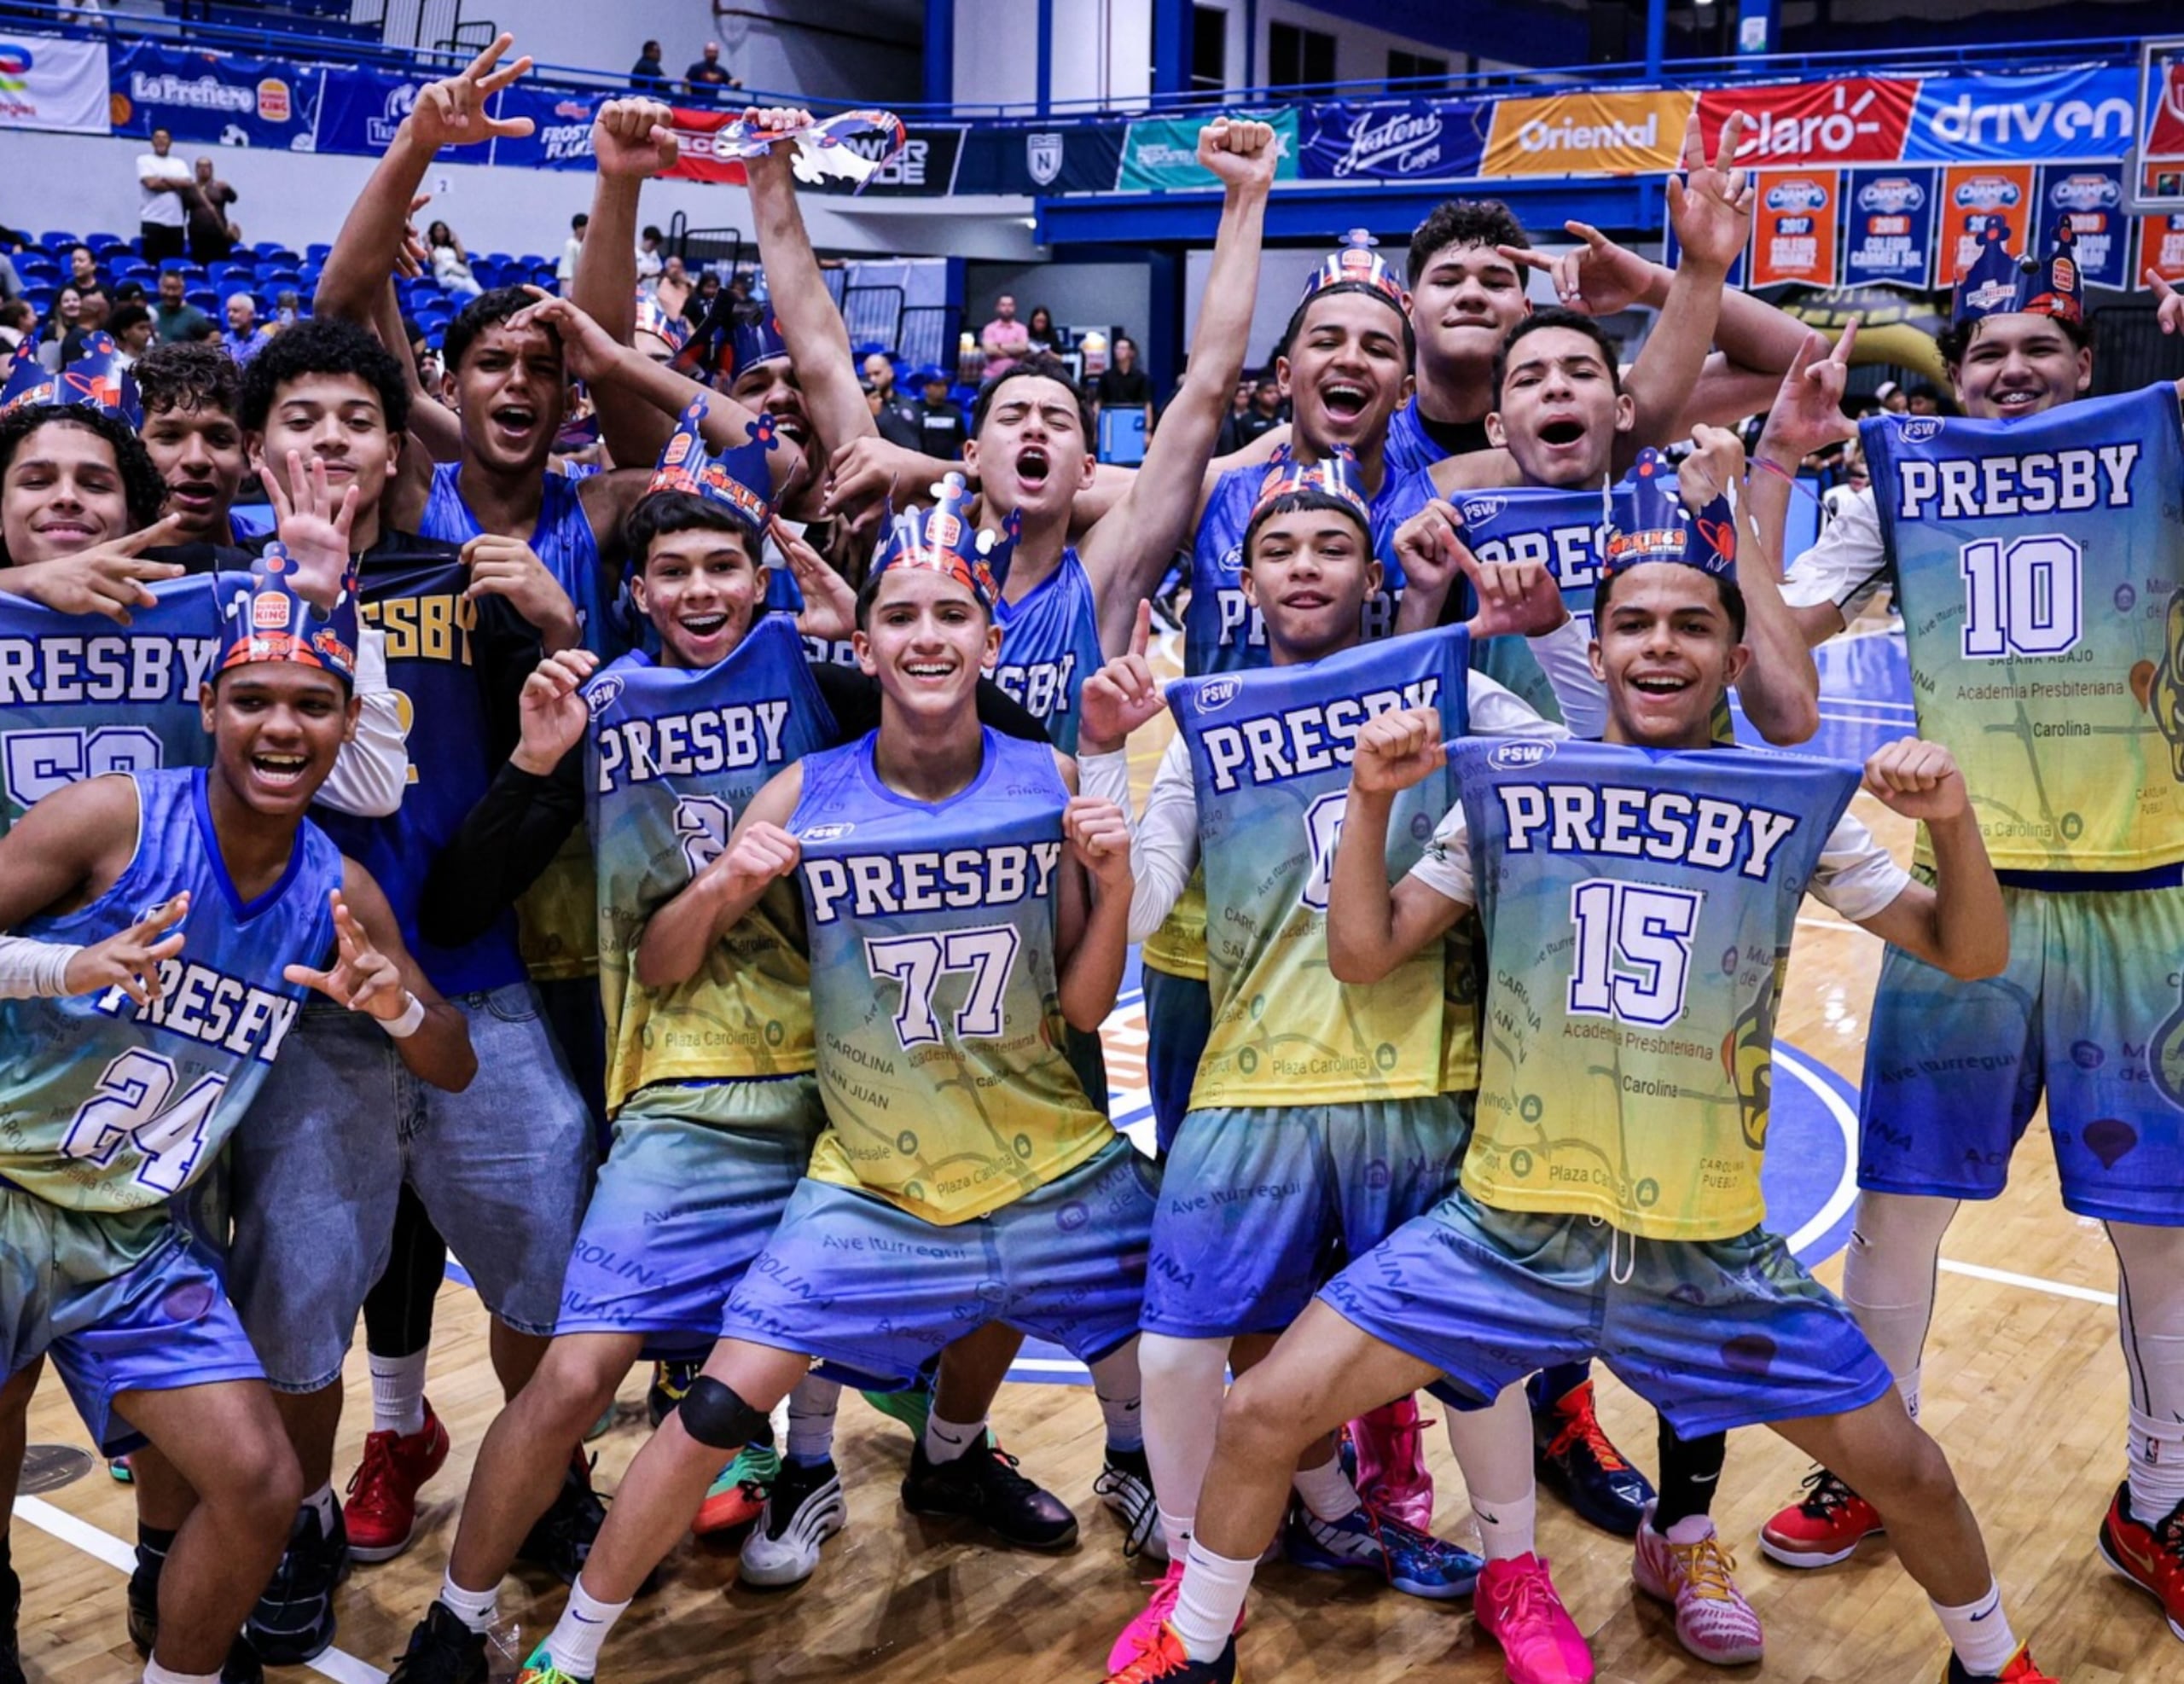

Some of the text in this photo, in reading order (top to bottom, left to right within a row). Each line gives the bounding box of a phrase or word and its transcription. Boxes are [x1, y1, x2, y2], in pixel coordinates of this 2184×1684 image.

[259, 101, 288, 112] KING
[1930, 94, 2133, 144] driven
[1333, 112, 1442, 177] Jostens
[1519, 113, 1658, 152] Oriental
[1720, 110, 1858, 156] Claro
[546, 139, 595, 159] FLAKE
[1903, 417, 1936, 436] PSW
[1899, 444, 2139, 519] PRESBY
[1464, 502, 1498, 521] PSW
[1960, 533, 2082, 659] 10
[256, 610, 288, 620] KING
[586, 682, 616, 711] PSW
[1200, 682, 1235, 703] PSW
[1955, 680, 2124, 701] Academia Presbiteriana
[2032, 720, 2091, 738] Carolina
[598, 700, 789, 793] PRESBY
[1497, 745, 1545, 763] PSW
[1497, 783, 1797, 879] PRESBY
[804, 841, 1062, 924] PRESBY
[1567, 878, 1705, 1030] 15
[863, 922, 1022, 1052] 77
[665, 1029, 758, 1048] Plaza Carolina
[1625, 1031, 1714, 1062] Presbiteriana
[825, 1031, 897, 1077] CAROLINA
[1271, 1054, 1367, 1076] Plaza Carolina
[848, 1084, 891, 1112] JUAN
[1622, 1075, 1678, 1099] Carolina
[57, 1046, 229, 1197] 24
[1549, 1164, 1589, 1182] Plaza
[937, 1176, 972, 1198] Plaza
[1170, 1196, 1208, 1217] Ave
[822, 1234, 865, 1251] Ave
